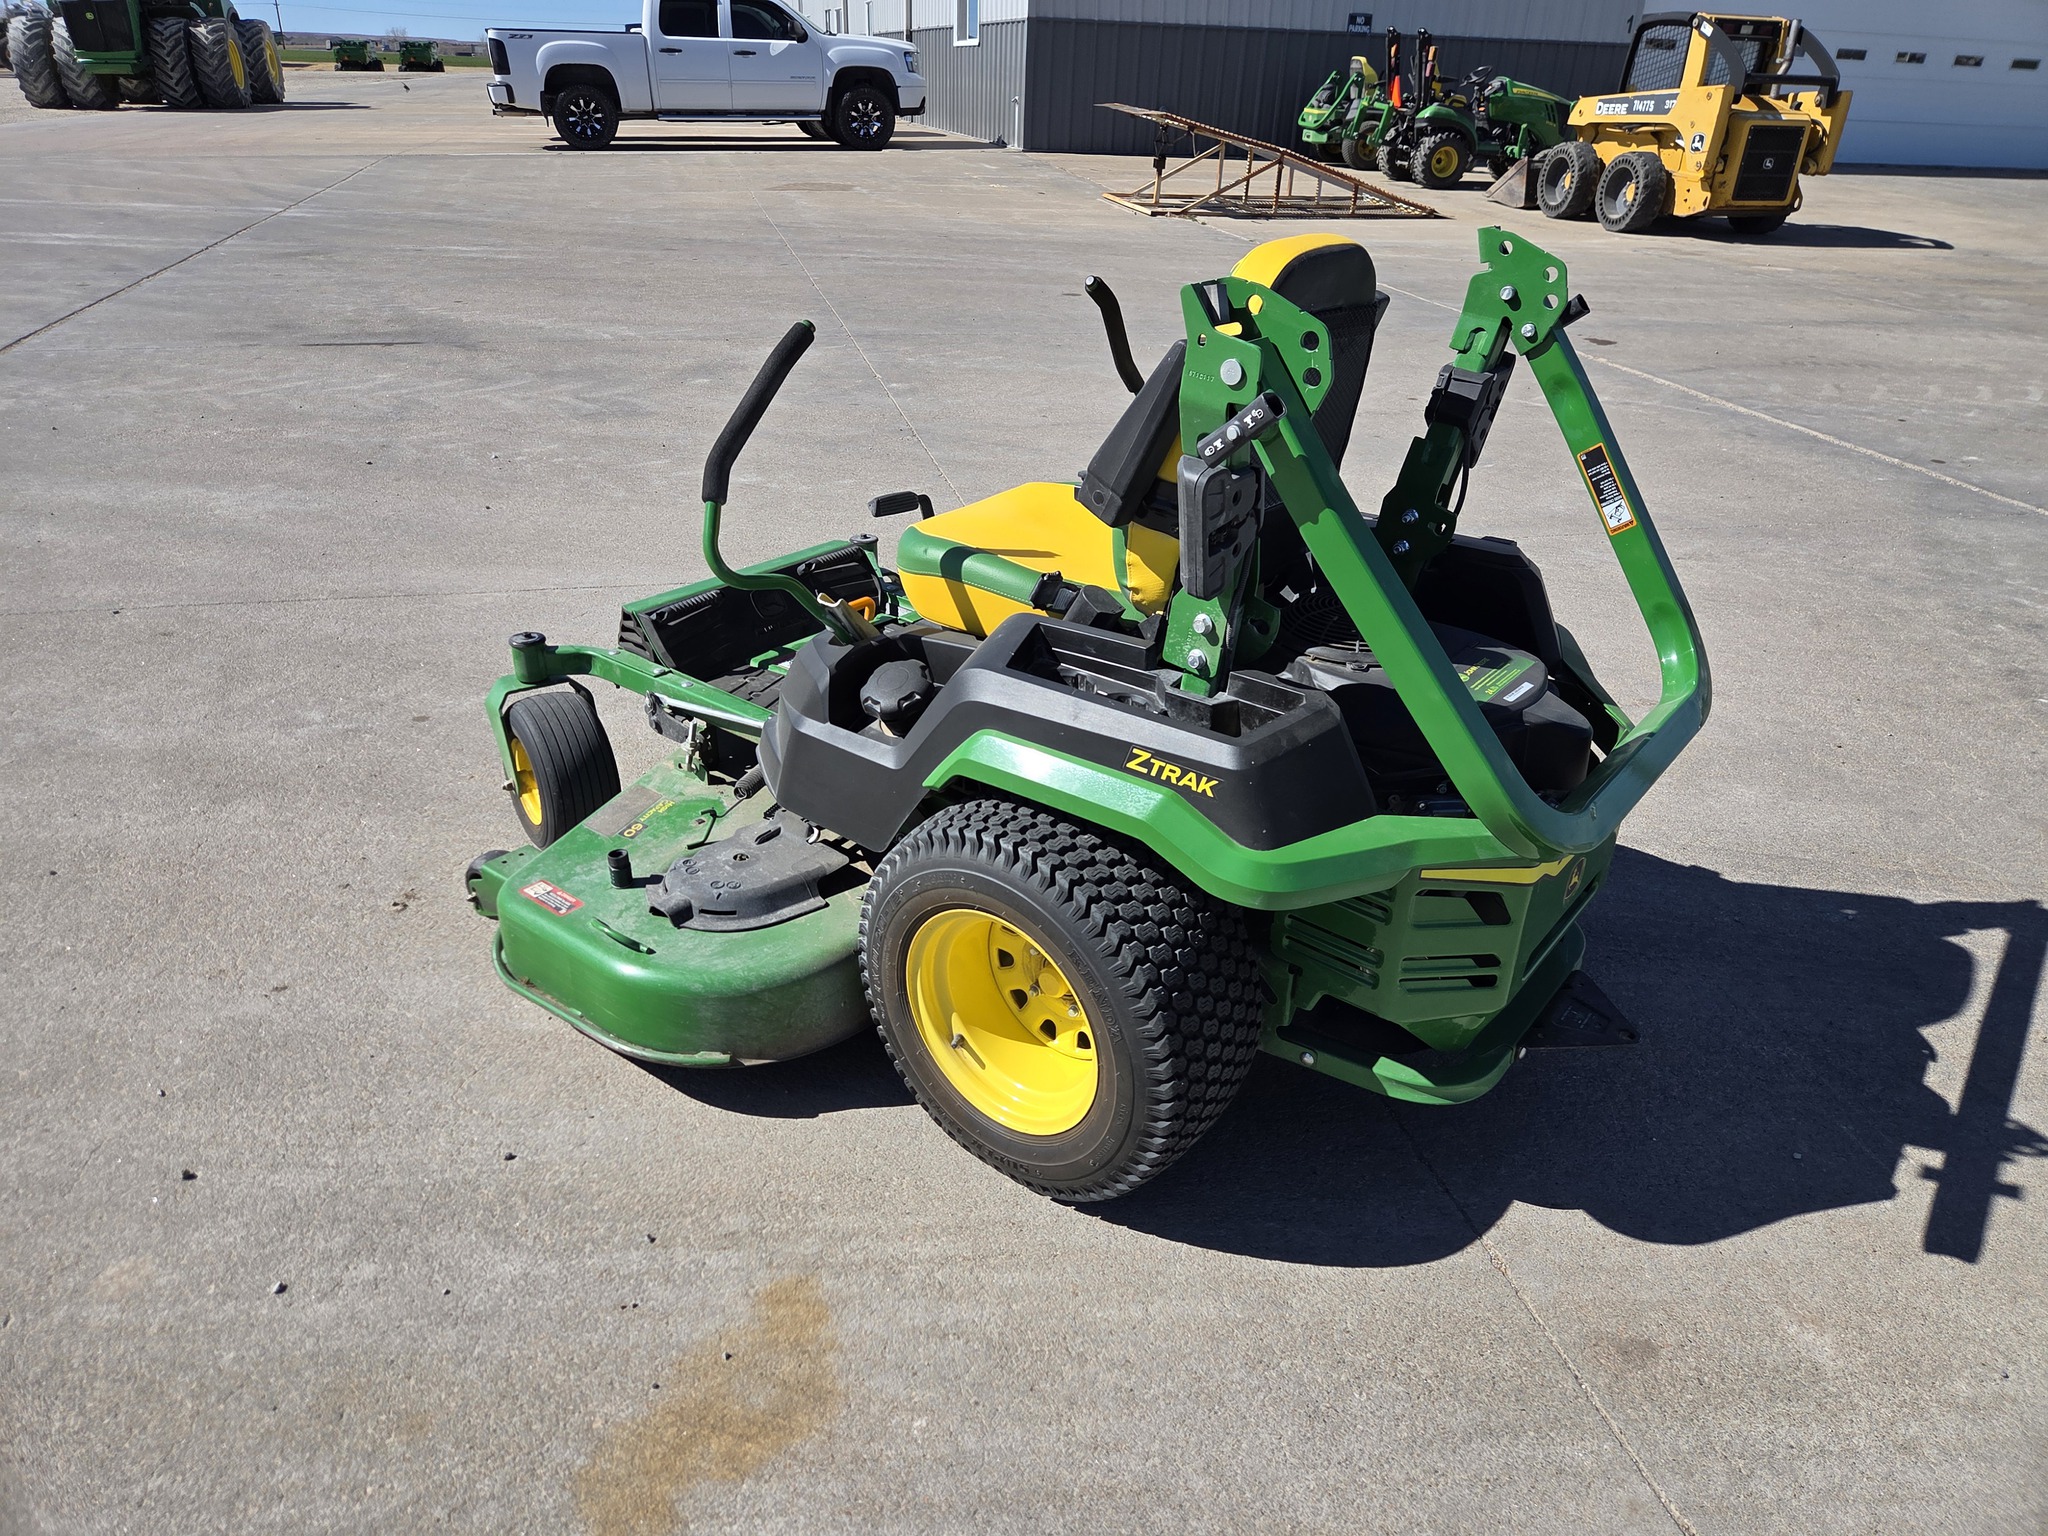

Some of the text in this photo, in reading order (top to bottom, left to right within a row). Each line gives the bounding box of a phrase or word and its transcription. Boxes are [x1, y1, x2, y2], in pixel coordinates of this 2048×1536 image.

[1356, 16, 1365, 25] NO
[1595, 102, 1628, 115] DEERE
[1126, 748, 1219, 798] ZTRAK
[623, 823, 643, 837] 60
[1067, 948, 1122, 1045] KENDA
